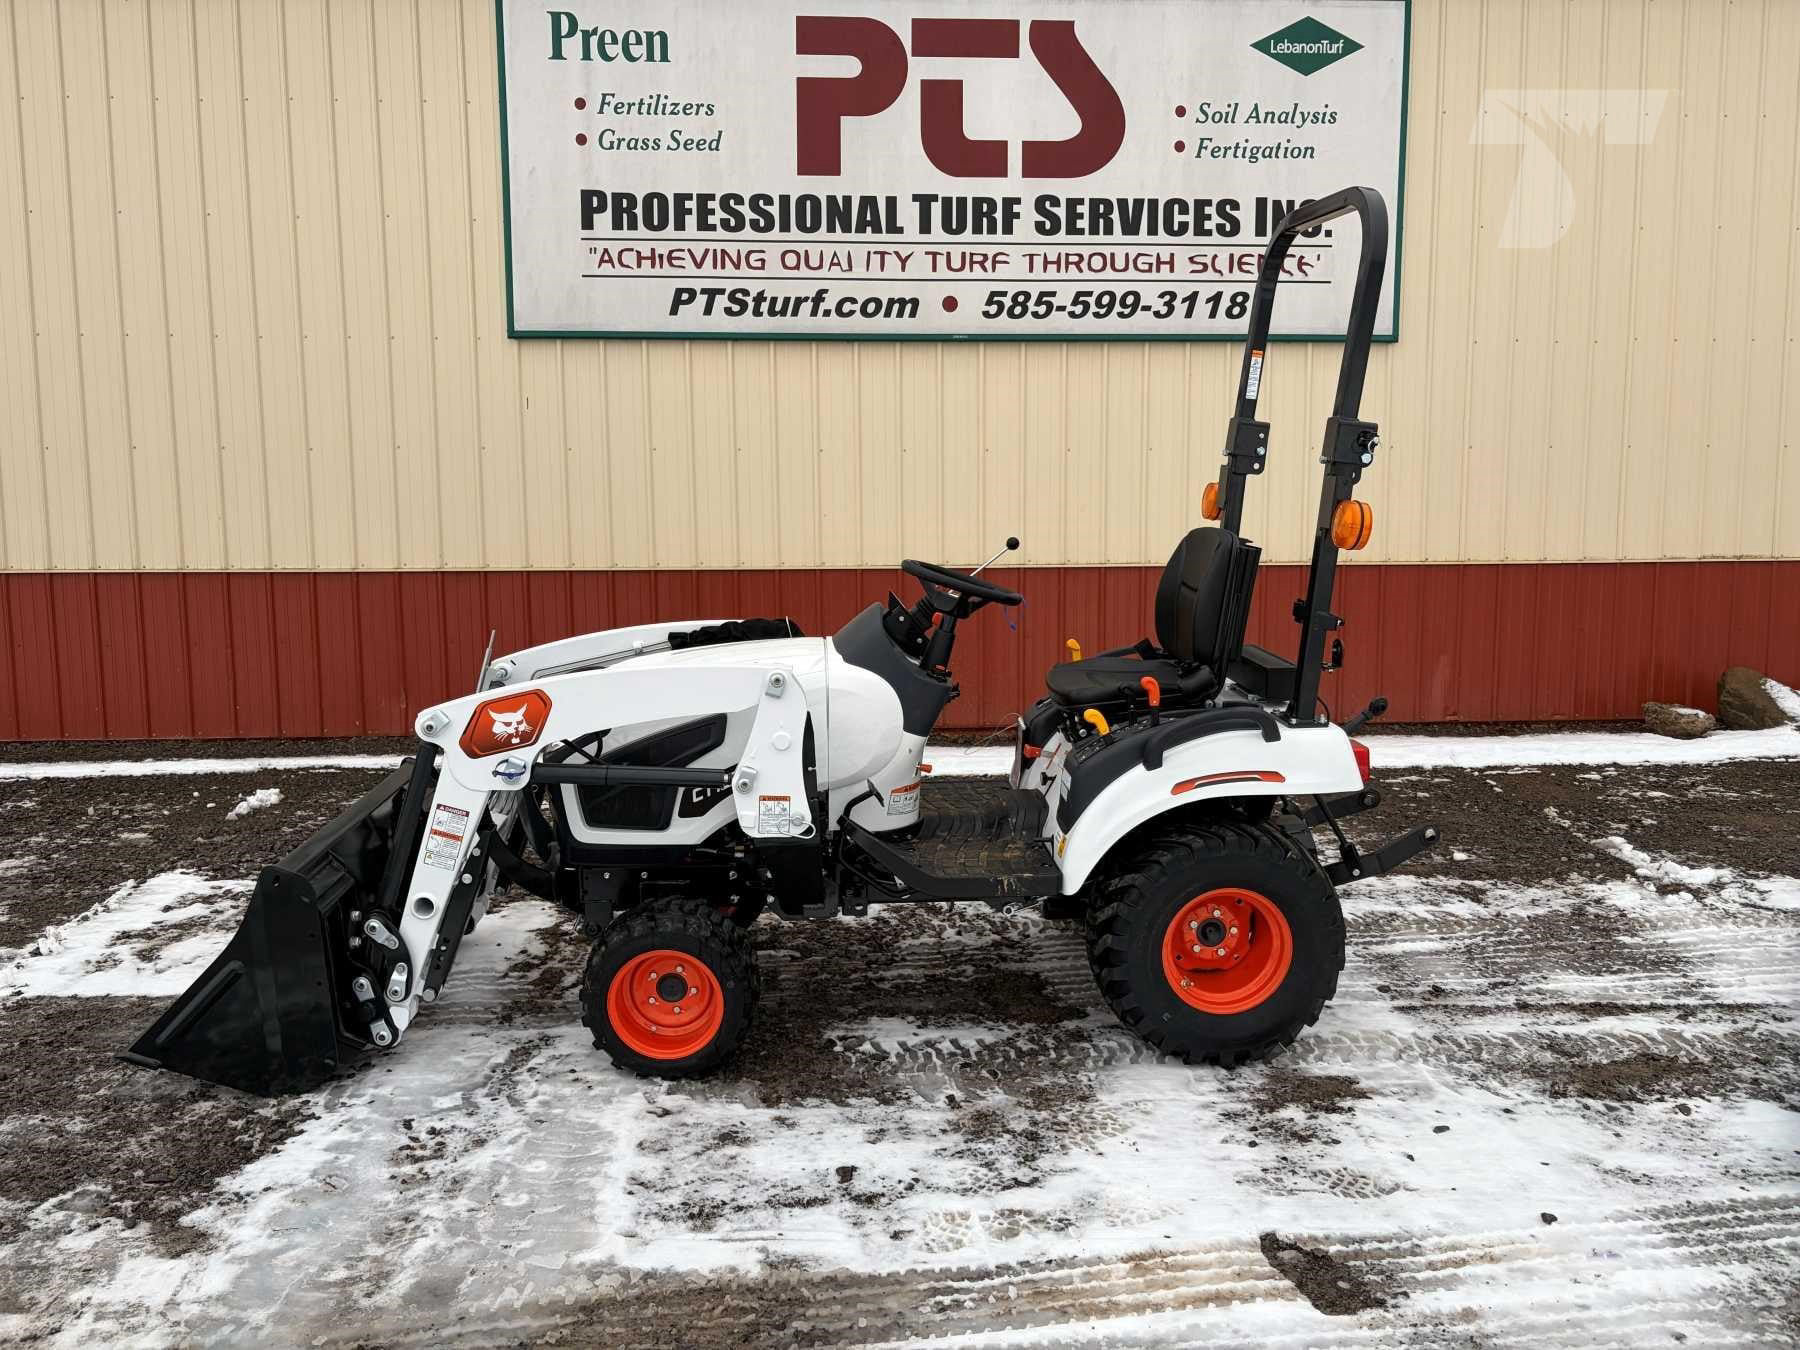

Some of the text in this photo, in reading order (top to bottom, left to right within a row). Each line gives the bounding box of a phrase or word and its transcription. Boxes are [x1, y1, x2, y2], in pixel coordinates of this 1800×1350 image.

[547, 11, 671, 62] Preen
[1270, 38, 1344, 54] LebanonTurf
[597, 93, 714, 116] Fertilizers
[796, 16, 1126, 178] PTS
[1195, 102, 1338, 129] Soil Analysis
[598, 129, 722, 152] Grass Seed
[1195, 138, 1315, 164] Fertigation
[580, 189, 904, 235] PROFESSIONAL
[911, 194, 1021, 236] TURF
[1033, 194, 1240, 238] SERVICES
[925, 251, 1010, 273] TURF
[1023, 252, 1175, 274] THROUGH
[669, 287, 1250, 320] PTSturf.com 585-599-3118
